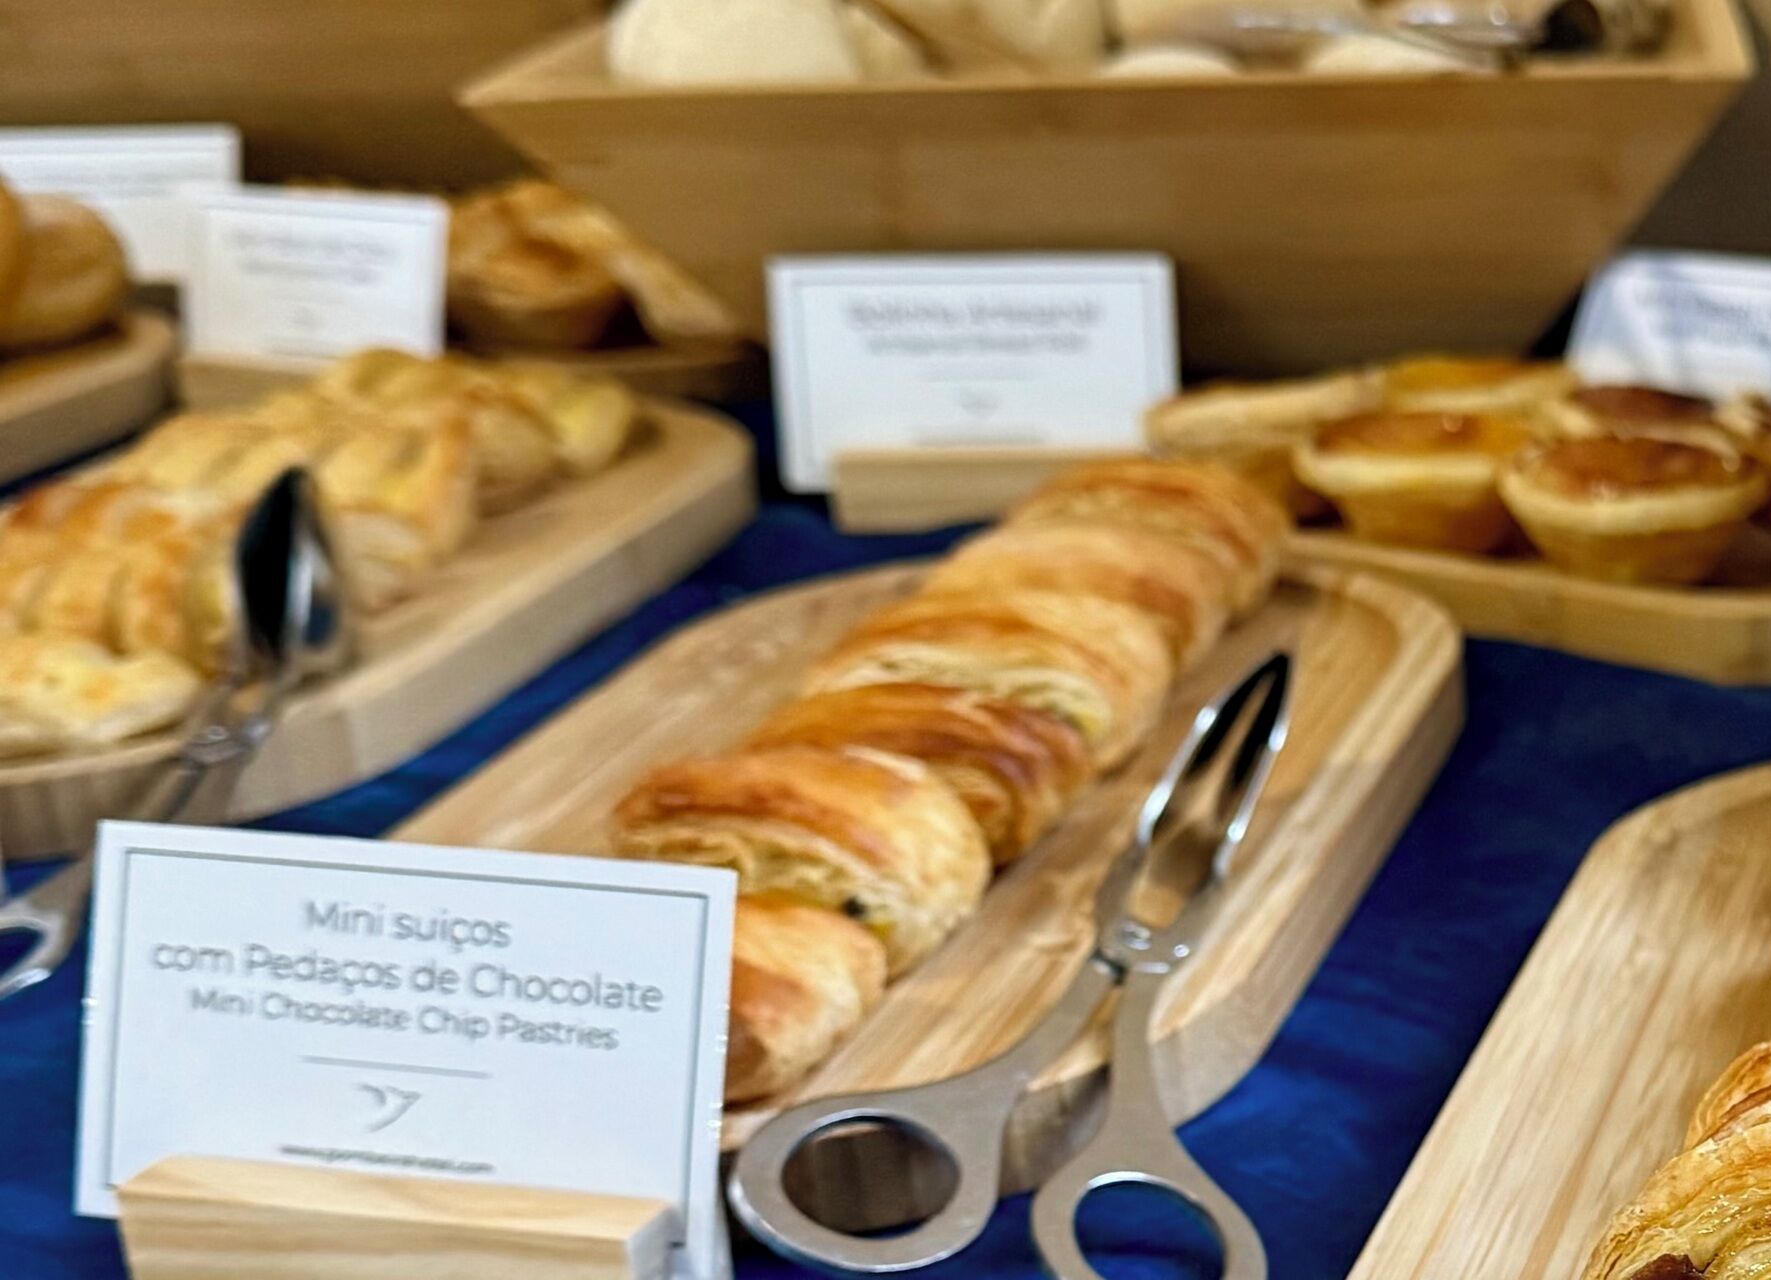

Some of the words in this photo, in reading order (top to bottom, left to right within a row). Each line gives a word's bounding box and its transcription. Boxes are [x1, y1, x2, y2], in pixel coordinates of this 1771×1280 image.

[305, 899, 383, 937] Mini
[391, 908, 513, 954] suiços
[152, 941, 234, 974] com
[245, 942, 402, 996] Pedaços
[410, 958, 461, 995] de
[470, 961, 664, 1013] Chocolate
[189, 986, 254, 1017] Mini
[261, 990, 408, 1032] Chocolate
[416, 1004, 490, 1042] Chip
[495, 1010, 620, 1051] Pastries
